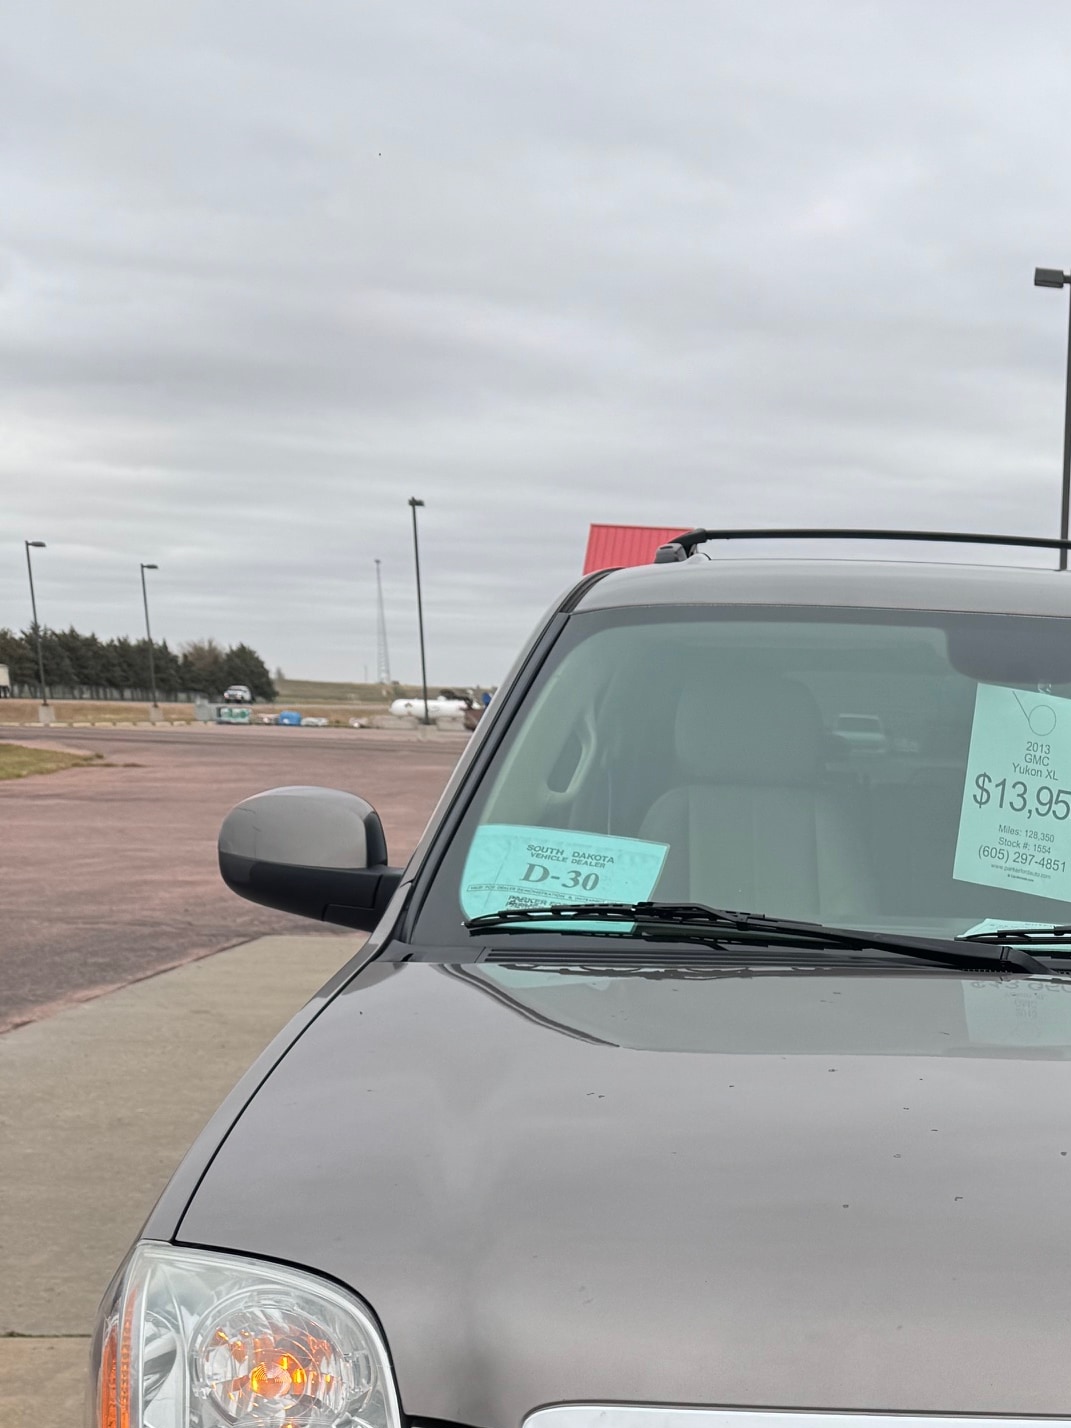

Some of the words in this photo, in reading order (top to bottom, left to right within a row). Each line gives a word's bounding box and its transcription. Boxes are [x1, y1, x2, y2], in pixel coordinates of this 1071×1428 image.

[1026, 741, 1051, 755] 2013
[1024, 753, 1050, 767] GMC
[1012, 763, 1043, 778] Yukon
[1044, 768, 1059, 781] XL
[998, 824, 1022, 836] Miles:
[526, 844, 565, 856] SOUTH
[571, 850, 615, 864] DAKOTA
[998, 836, 1021, 849] Stock
[1033, 844, 1051, 854] 1554
[530, 852, 568, 863] VEHICLE
[571, 858, 606, 869] DEALER
[978, 845, 1010, 864] (605)
[1013, 851, 1067, 873] 297-4851
[519, 862, 600, 891] D-30
